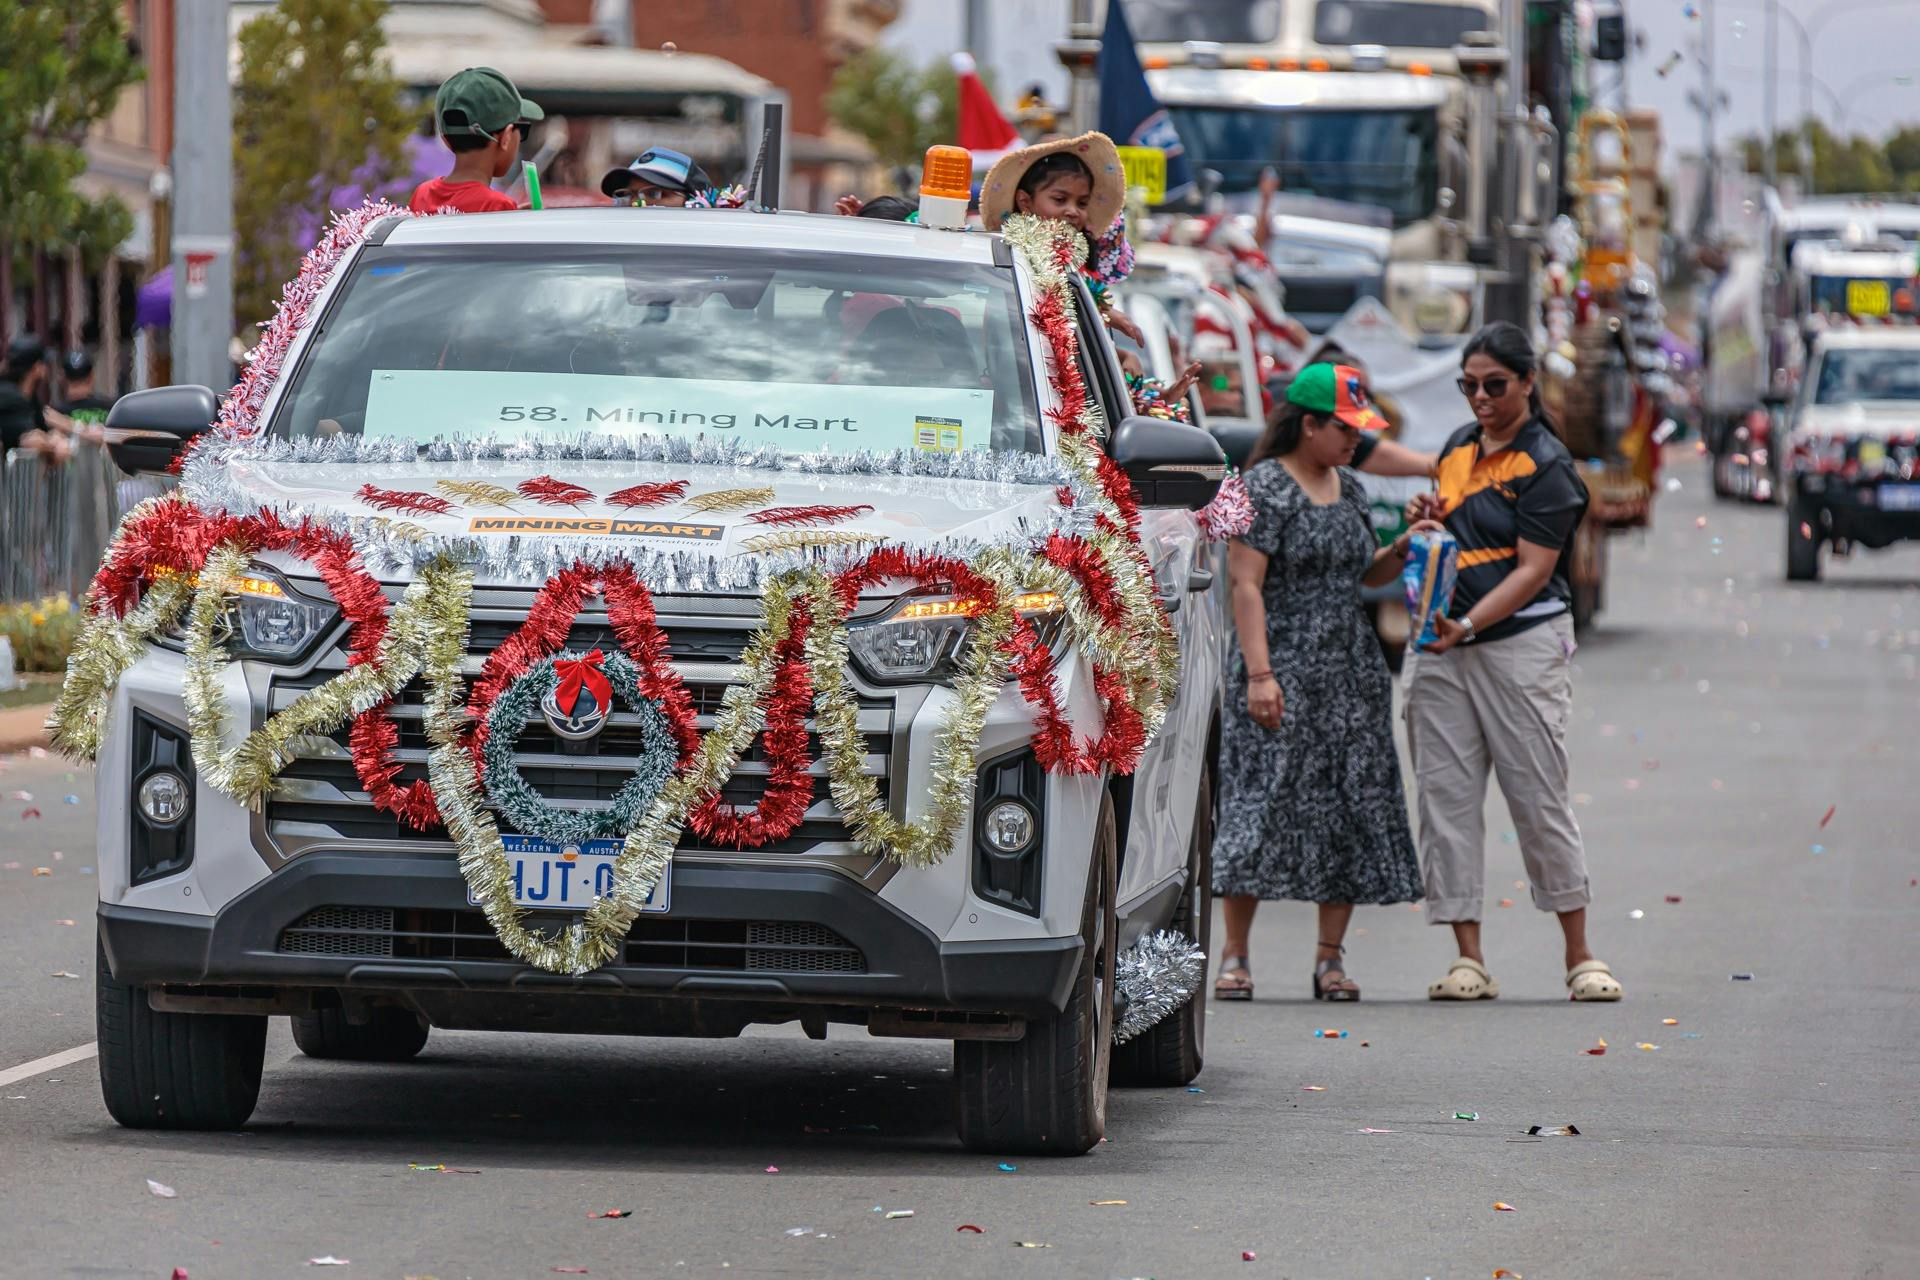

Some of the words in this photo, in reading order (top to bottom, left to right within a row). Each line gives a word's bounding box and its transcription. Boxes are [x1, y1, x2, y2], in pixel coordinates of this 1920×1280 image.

[499, 406, 568, 422] 58.
[586, 407, 737, 429] Mining
[755, 413, 860, 432] Mart
[474, 519, 608, 530] MINING
[615, 522, 721, 537] MART
[507, 844, 552, 853] WESTERN
[589, 847, 624, 856] AUSTRA
